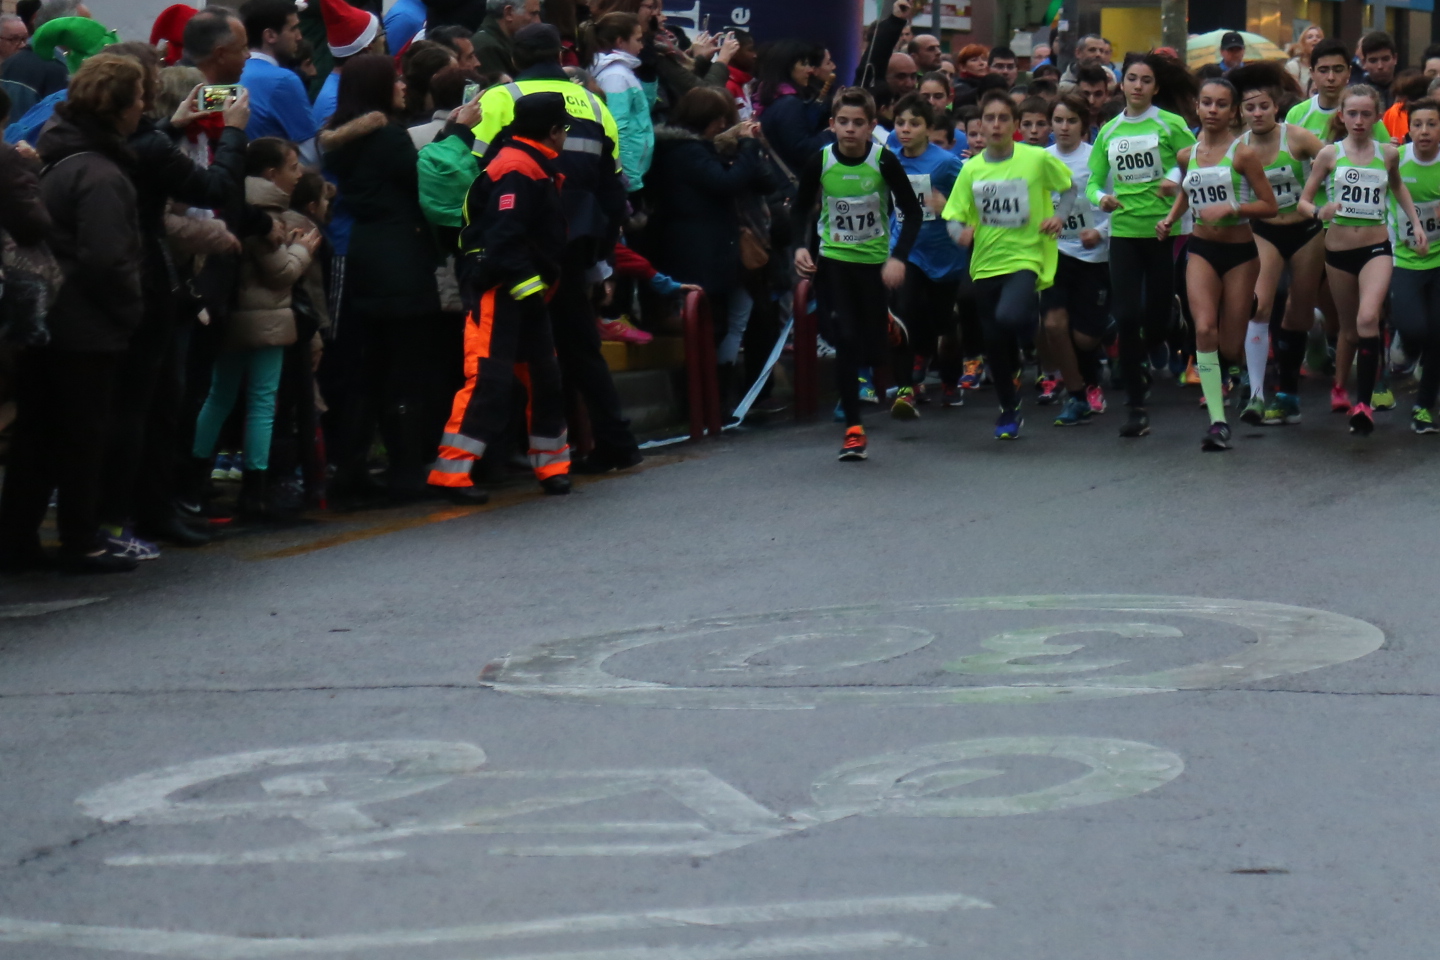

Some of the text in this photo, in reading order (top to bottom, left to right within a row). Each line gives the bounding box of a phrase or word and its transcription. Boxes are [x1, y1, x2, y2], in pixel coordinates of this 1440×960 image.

[724, 7, 750, 32] e
[1116, 152, 1154, 171] 2060
[1190, 185, 1227, 204] 2196
[1341, 185, 1380, 204] 2018
[982, 197, 1019, 214] 2441
[835, 211, 876, 231] 2178
